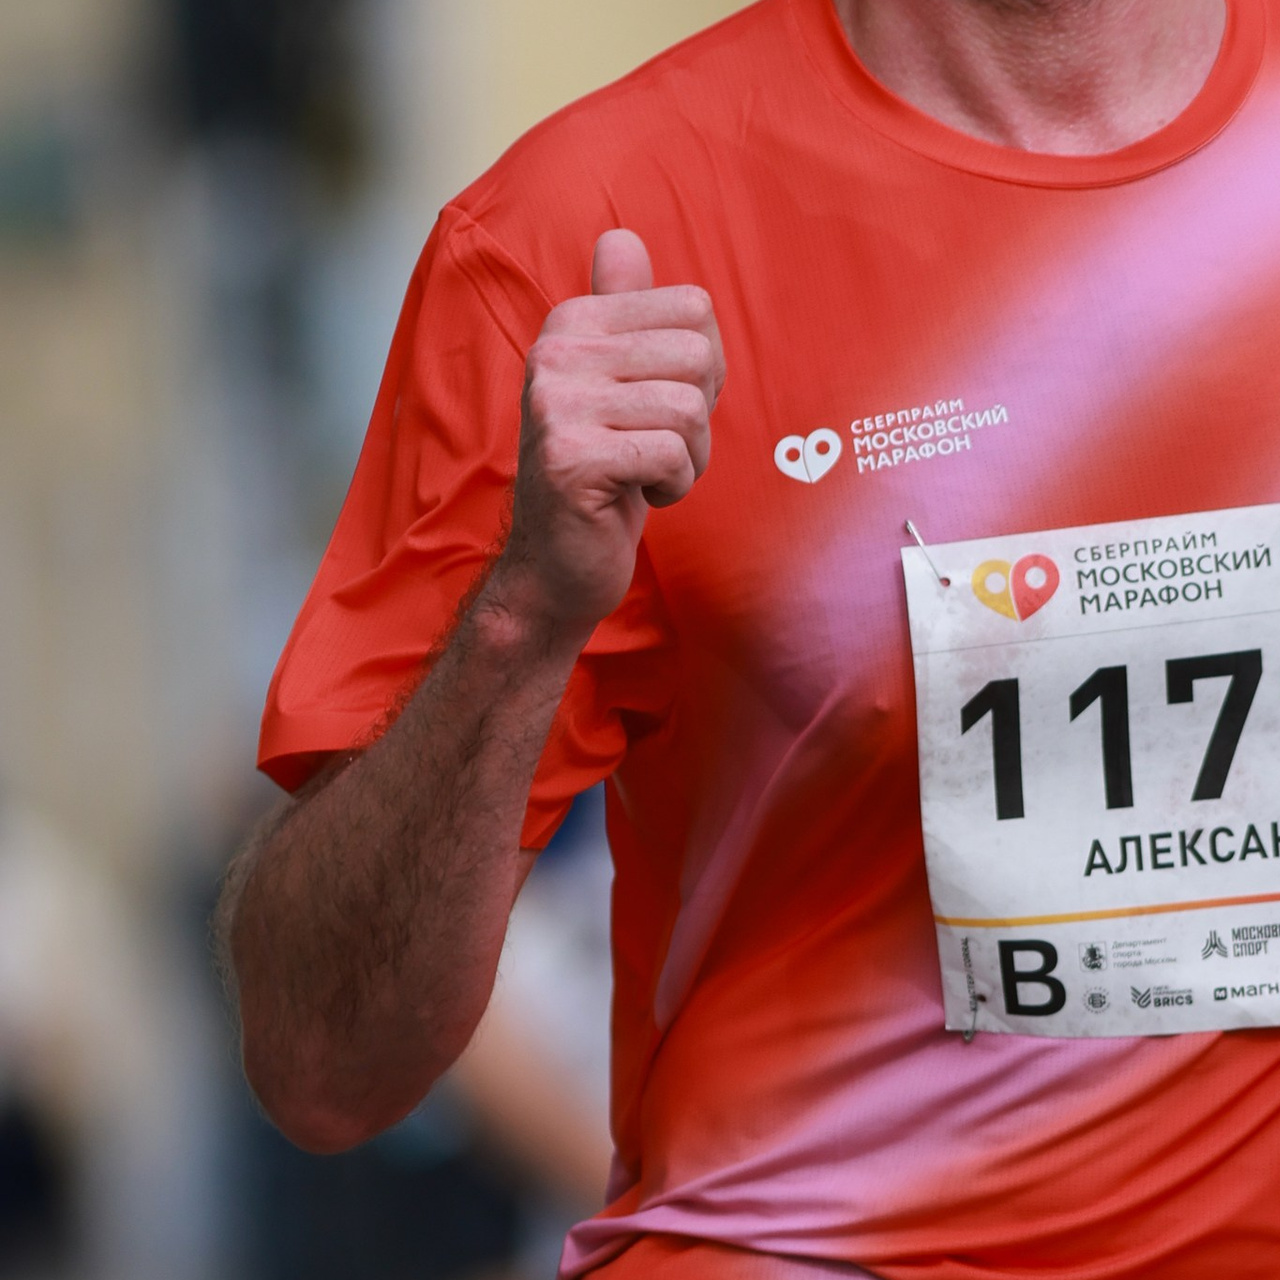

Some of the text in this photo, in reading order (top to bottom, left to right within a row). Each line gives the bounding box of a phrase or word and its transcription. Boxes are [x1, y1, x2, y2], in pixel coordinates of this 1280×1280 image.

[850, 398, 964, 434] СБЕРПРАЙМ
[853, 404, 1009, 454] МОСКОВСКИЙ
[857, 434, 971, 474] МАРАФОН
[1074, 531, 1217, 563] СБЕРПРАЙМ
[1077, 544, 1272, 589] МОСКОВСКИЙ
[1080, 579, 1223, 614] МАРАФОН
[1233, 940, 1268, 958] СПОРТ
[1153, 995, 1194, 1008] BRICS
